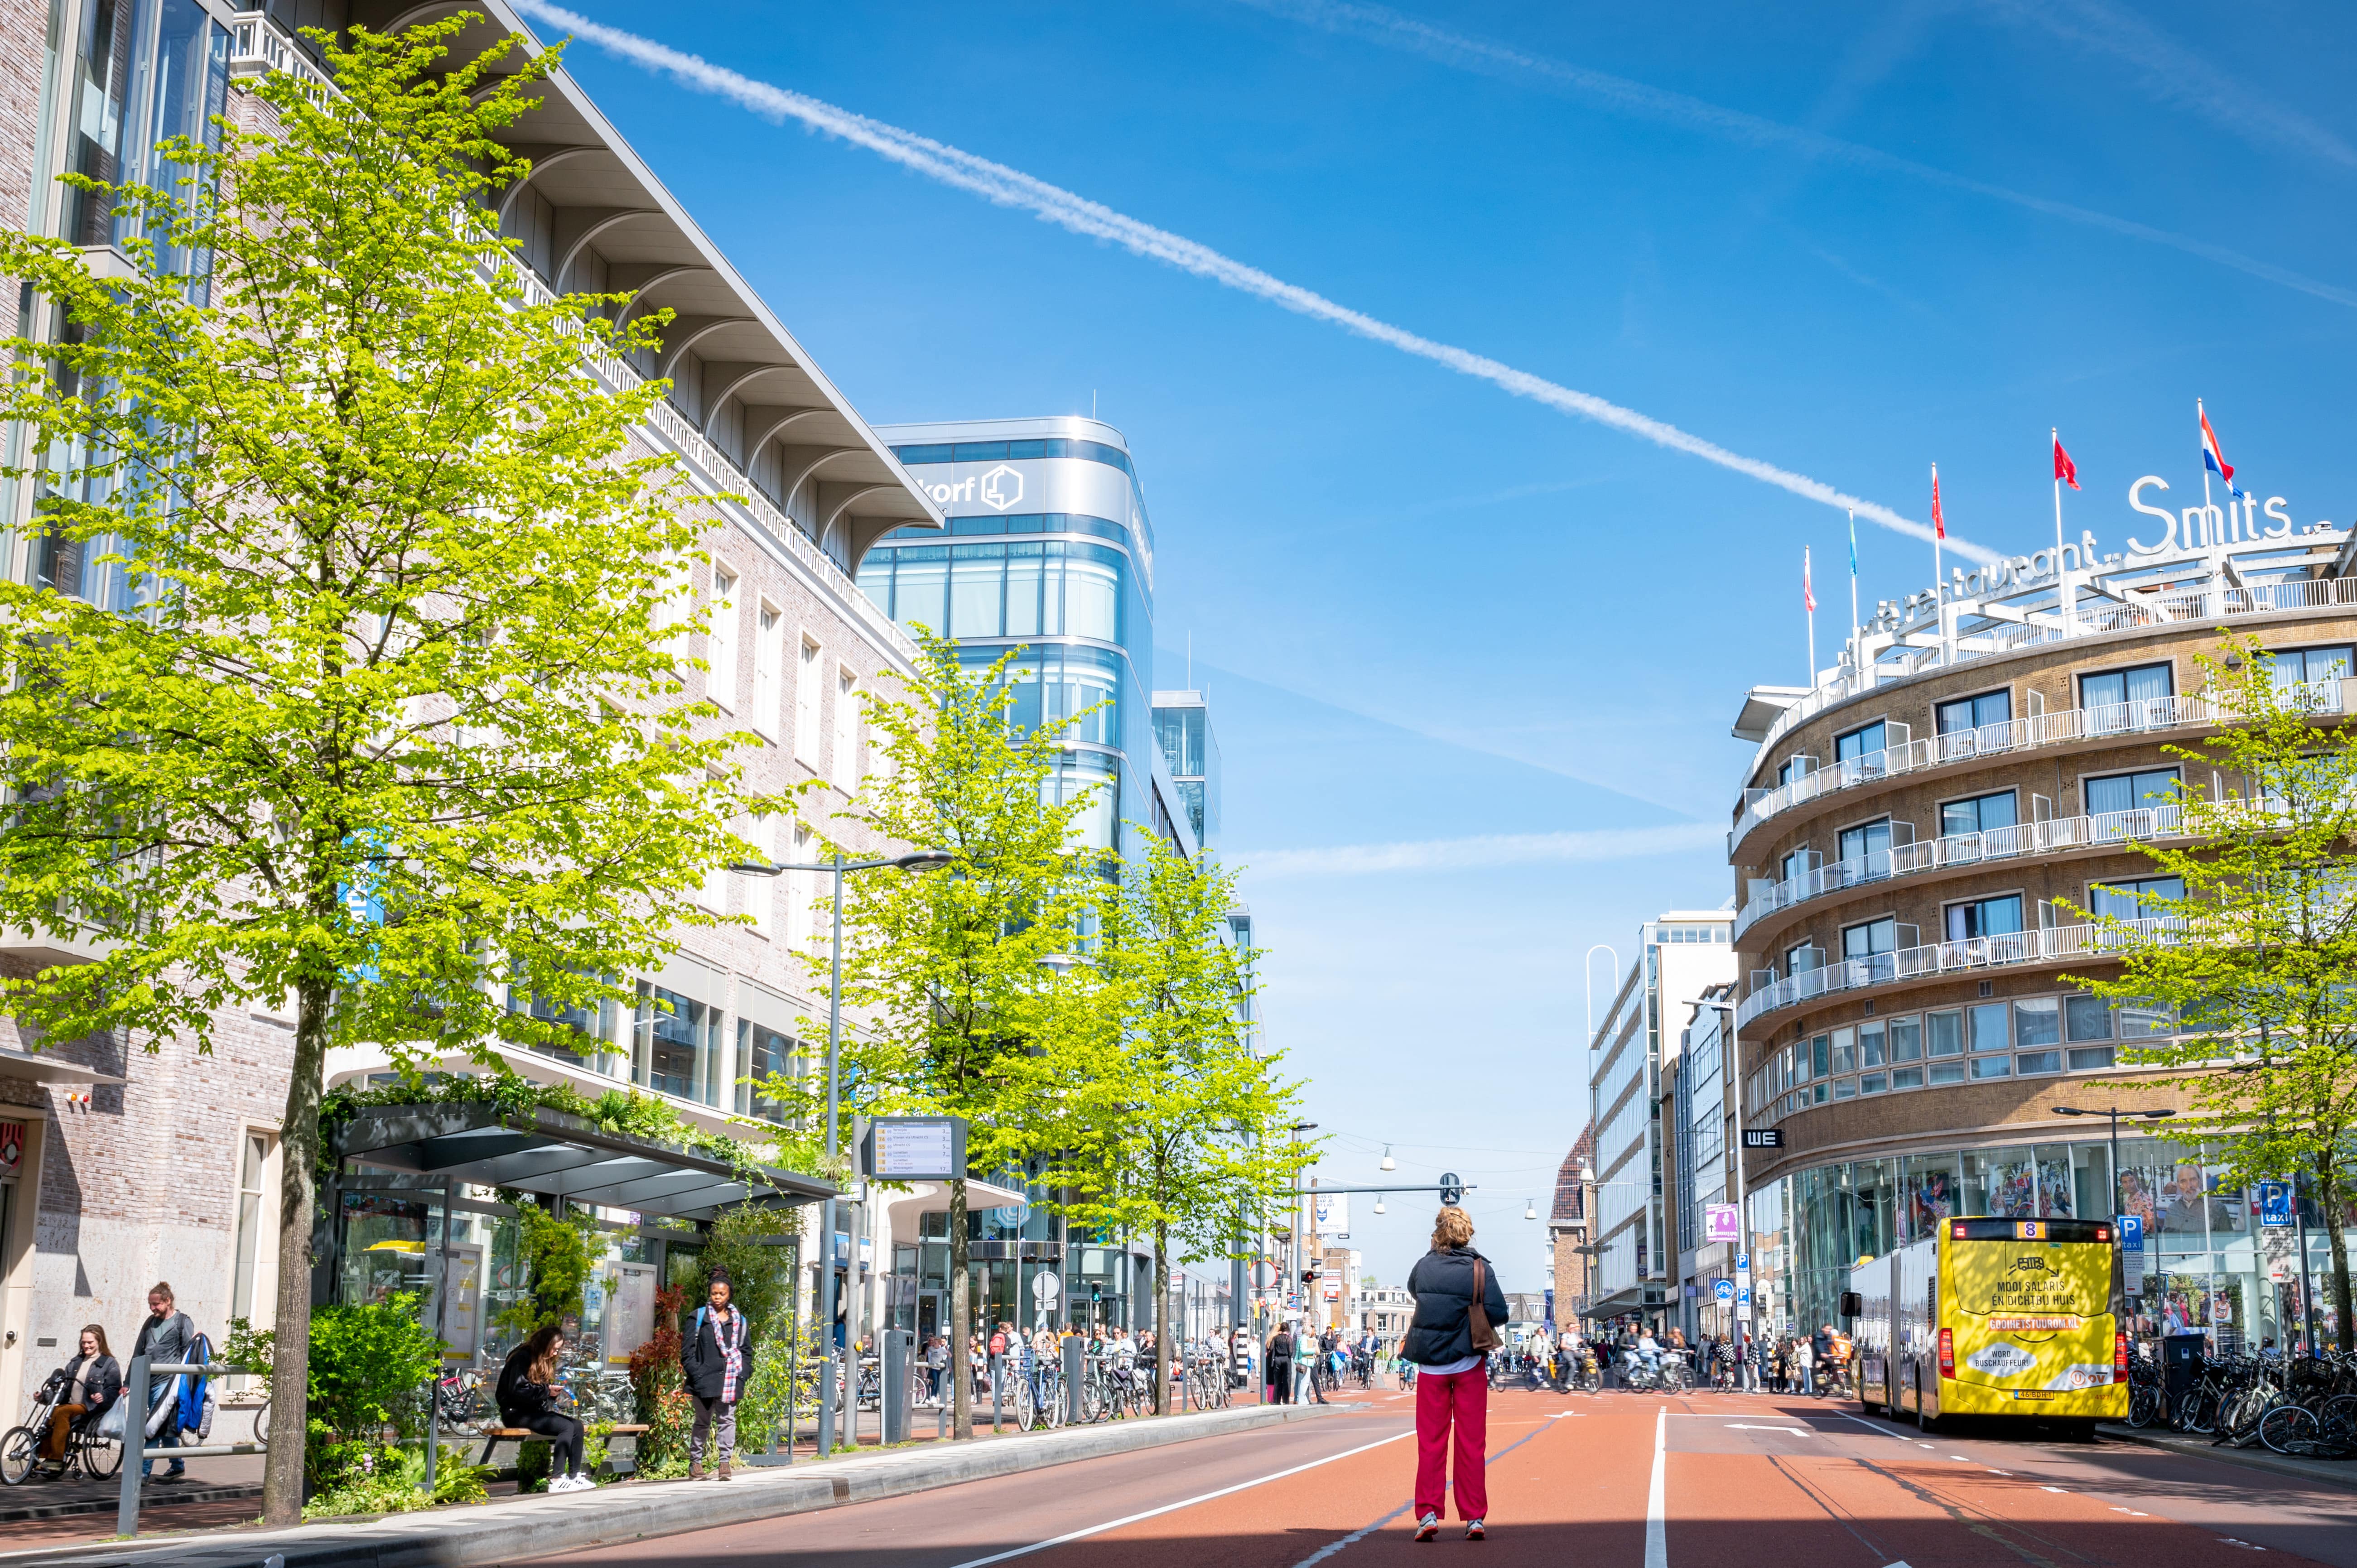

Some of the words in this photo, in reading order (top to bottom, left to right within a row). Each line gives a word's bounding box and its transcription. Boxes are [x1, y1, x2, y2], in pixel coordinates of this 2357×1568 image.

[2127, 475, 2292, 555] Smits
[1747, 1131, 1776, 1145] WE
[2267, 1185, 2283, 1208] P
[2265, 1212, 2288, 1222] taxi
[2025, 1222, 2036, 1237] 8
[2124, 1220, 2137, 1237] P
[1739, 1255, 1746, 1265] P
[1998, 1282, 2021, 1292] MOOI
[2025, 1281, 2065, 1291] SALARIS
[1740, 1289, 1747, 1299] P
[1992, 1294, 2004, 1306] ÉN
[2008, 1295, 2049, 1305] DICHTBIJ
[2053, 1294, 2075, 1305] HUIS
[1989, 1317, 2079, 1329] GOOIHETSTUUROM.NL
[1976, 1359, 2029, 1367] BUSCHAUFFEUR!
